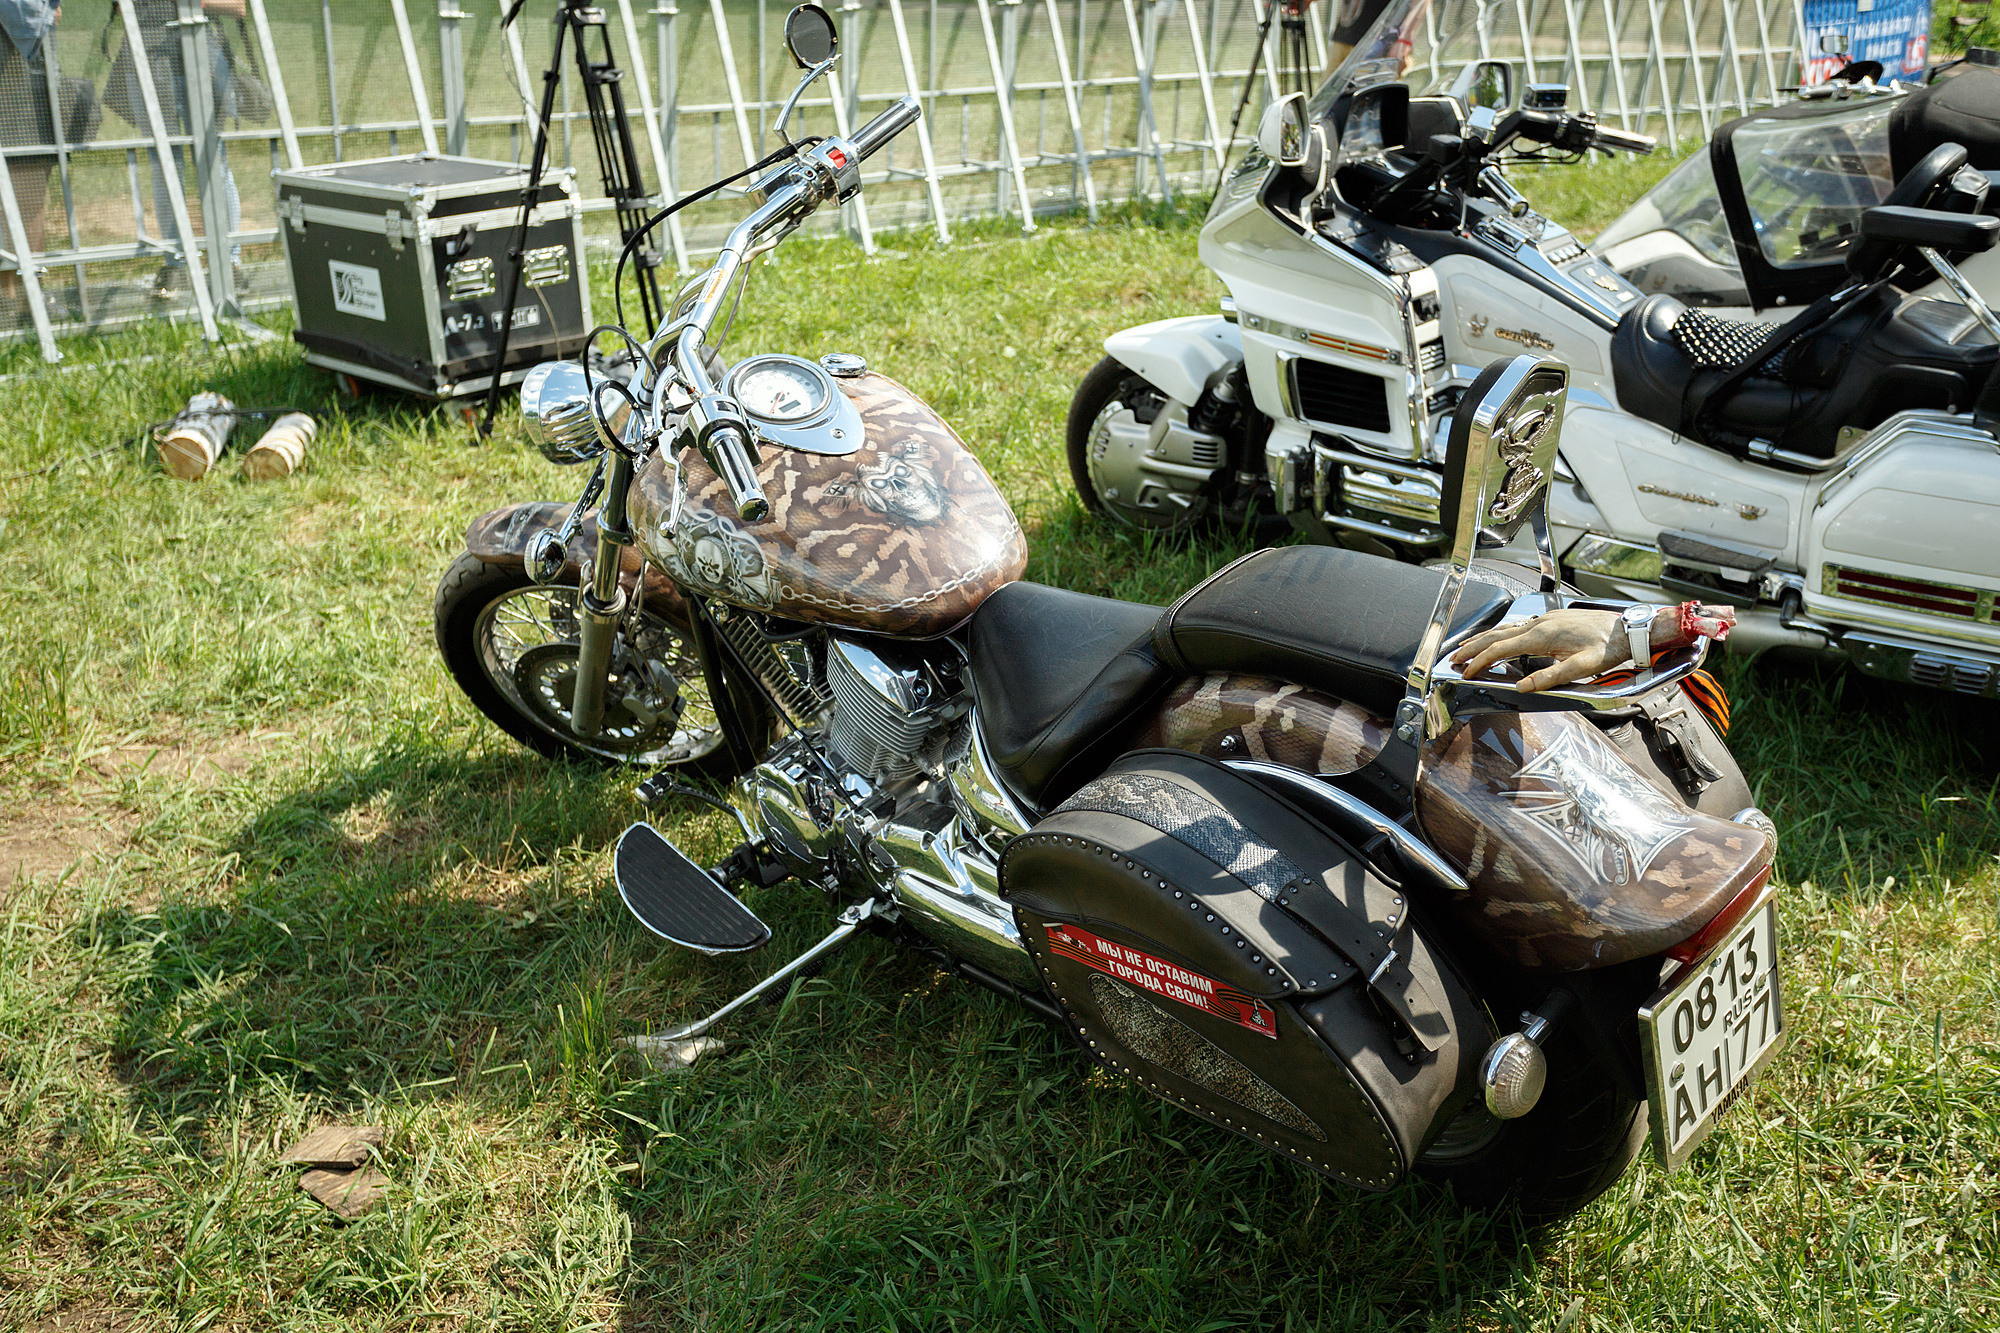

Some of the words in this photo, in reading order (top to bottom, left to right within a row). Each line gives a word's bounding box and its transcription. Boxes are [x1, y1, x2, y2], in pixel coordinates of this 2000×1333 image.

[1096, 939, 1122, 960] МЫ
[1124, 950, 1144, 968] НЕ
[1145, 958, 1214, 994] ОСТАВИМ
[1108, 960, 1164, 992] ГОРОДА
[1165, 982, 1209, 1010] СВОИ!
[1673, 926, 1758, 1054] 0813
[1723, 988, 1752, 1034] RUS
[1711, 1074, 1750, 1125] YAMAHA
